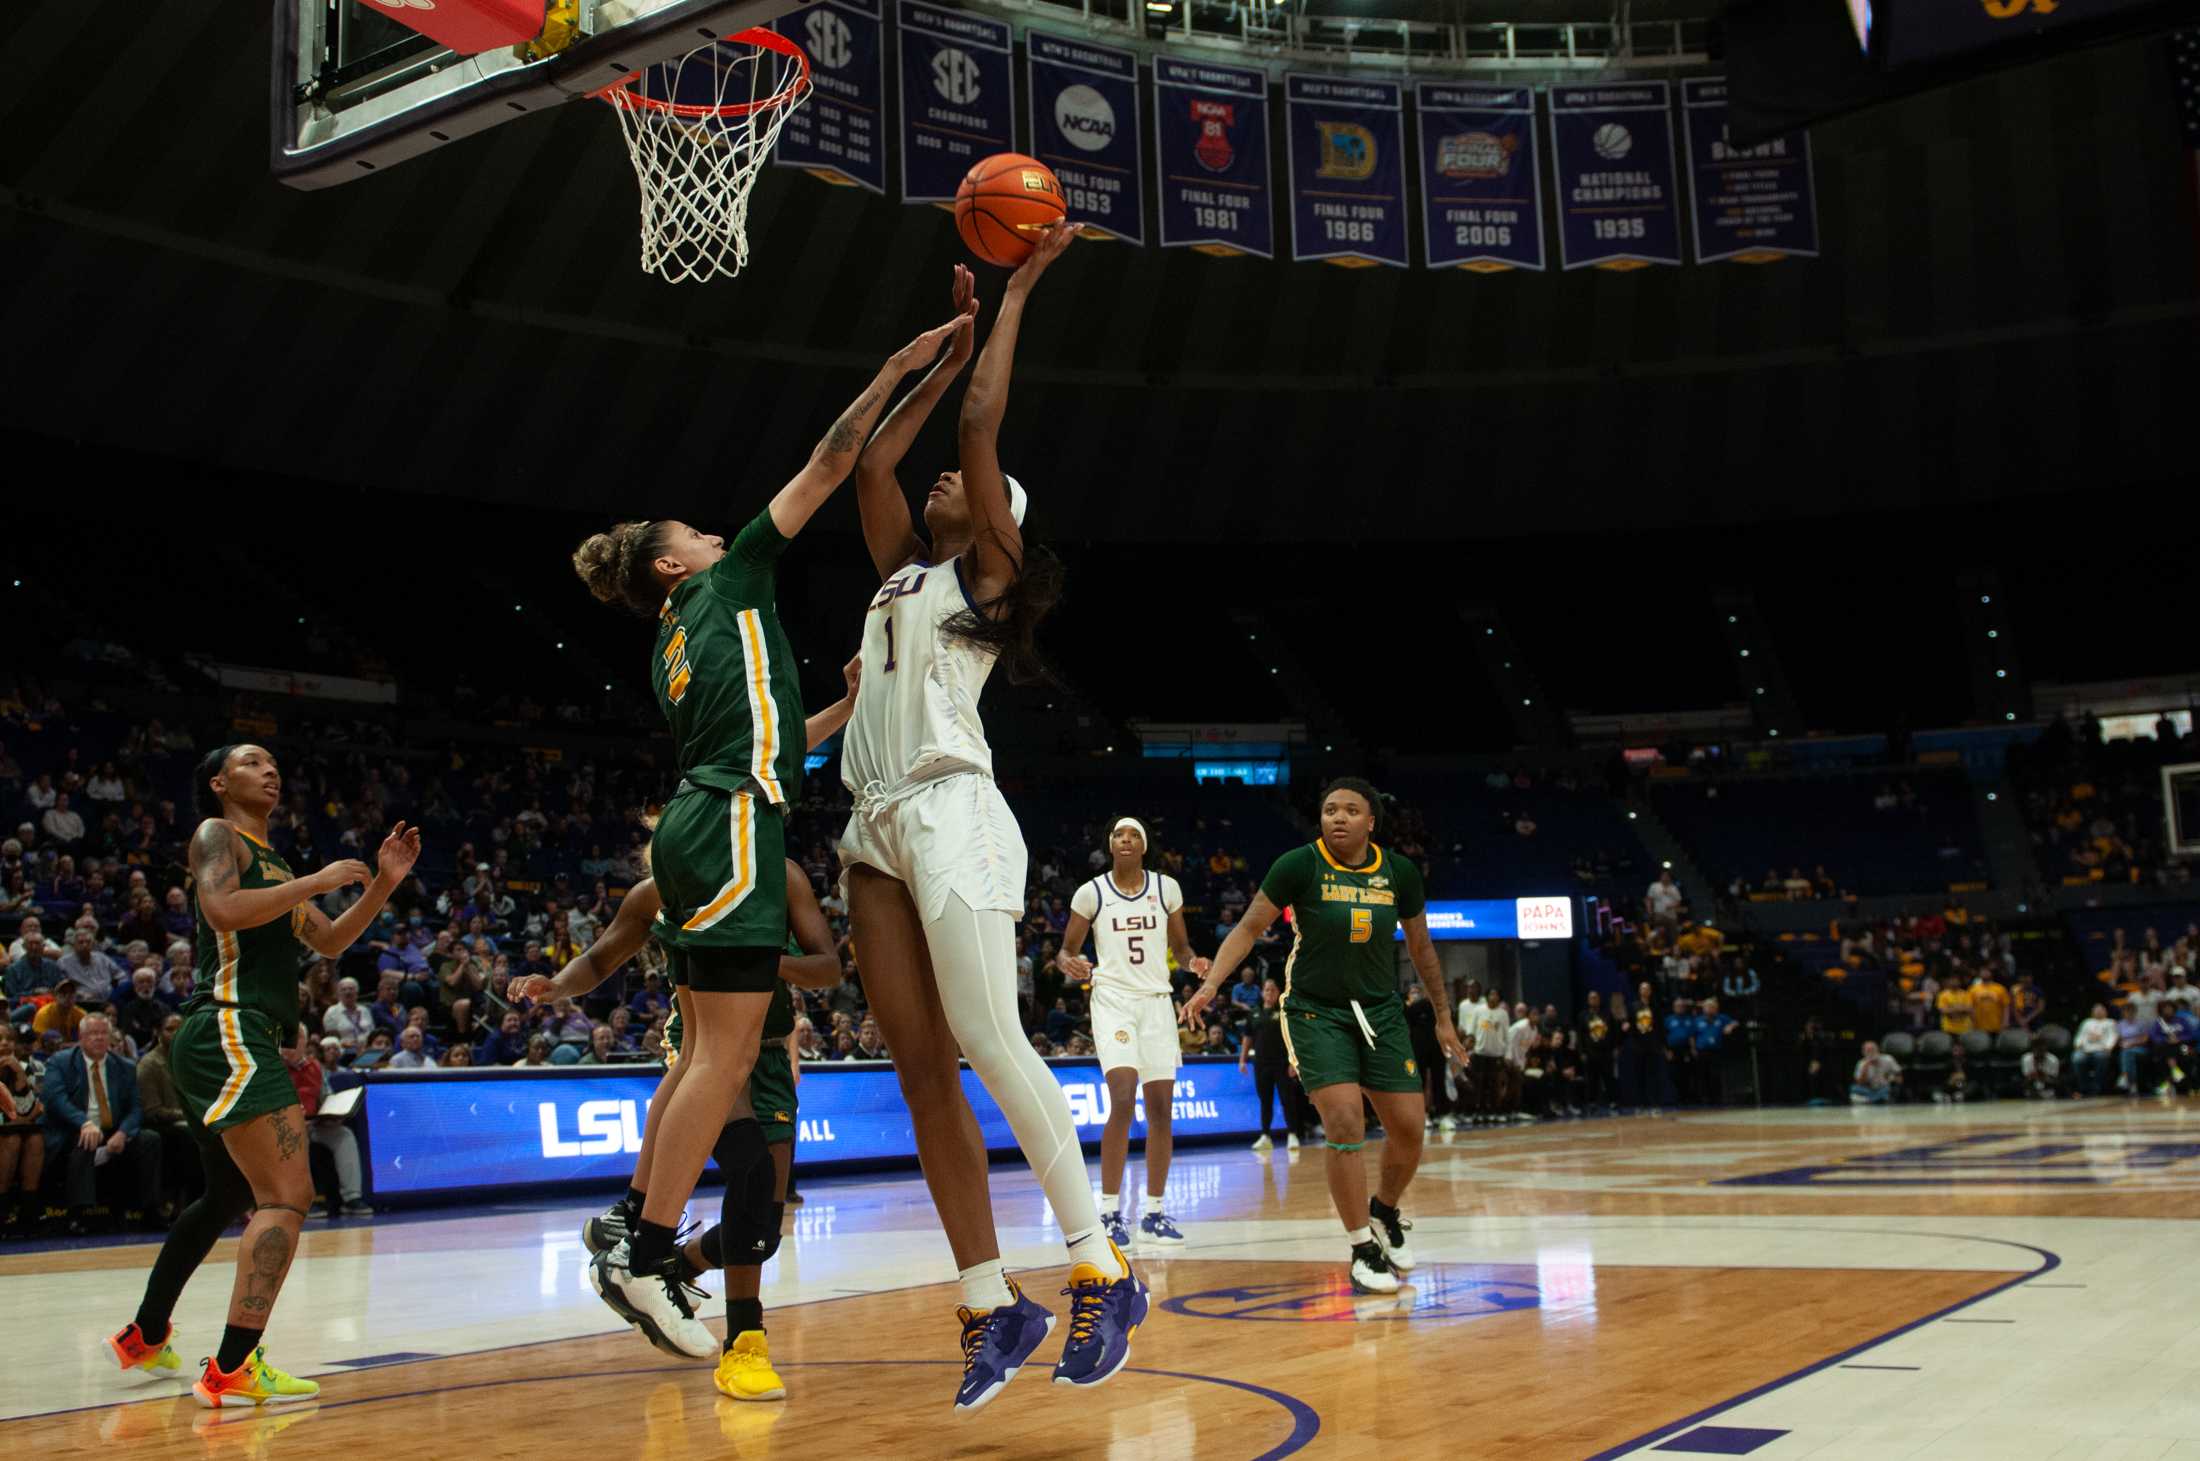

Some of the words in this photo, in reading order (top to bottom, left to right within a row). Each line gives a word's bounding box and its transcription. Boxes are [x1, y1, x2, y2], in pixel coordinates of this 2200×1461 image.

[804, 8, 853, 69] SEC
[931, 47, 982, 105] SEC
[1062, 113, 1113, 137] NCAA
[1055, 167, 1087, 188] FINAL
[1089, 172, 1121, 193] FOUR
[1579, 171, 1652, 187] NATIONAL
[1066, 188, 1113, 215] 1953
[1181, 188, 1216, 206] FINAL
[1218, 192, 1250, 209] FOUR
[1572, 185, 1663, 203] CHAMPIONS
[1193, 206, 1239, 232] 1981
[1313, 203, 1349, 219] FINAL
[1351, 205, 1384, 221] FOUR
[1446, 208, 1481, 224] FINAL
[1484, 209, 1518, 225] FOUR
[1324, 219, 1375, 243] 1986
[1455, 225, 1511, 246] 2006
[1593, 217, 1646, 240] 1935
[884, 616, 897, 672] 1
[663, 626, 692, 706] 2
[1522, 903, 1565, 919] PAPA
[1112, 915, 1157, 932] LSU
[1349, 907, 1372, 944] 5
[1128, 935, 1145, 965] 5
[1062, 1082, 1112, 1126] SU
[1134, 1099, 1219, 1123] BETBALL
